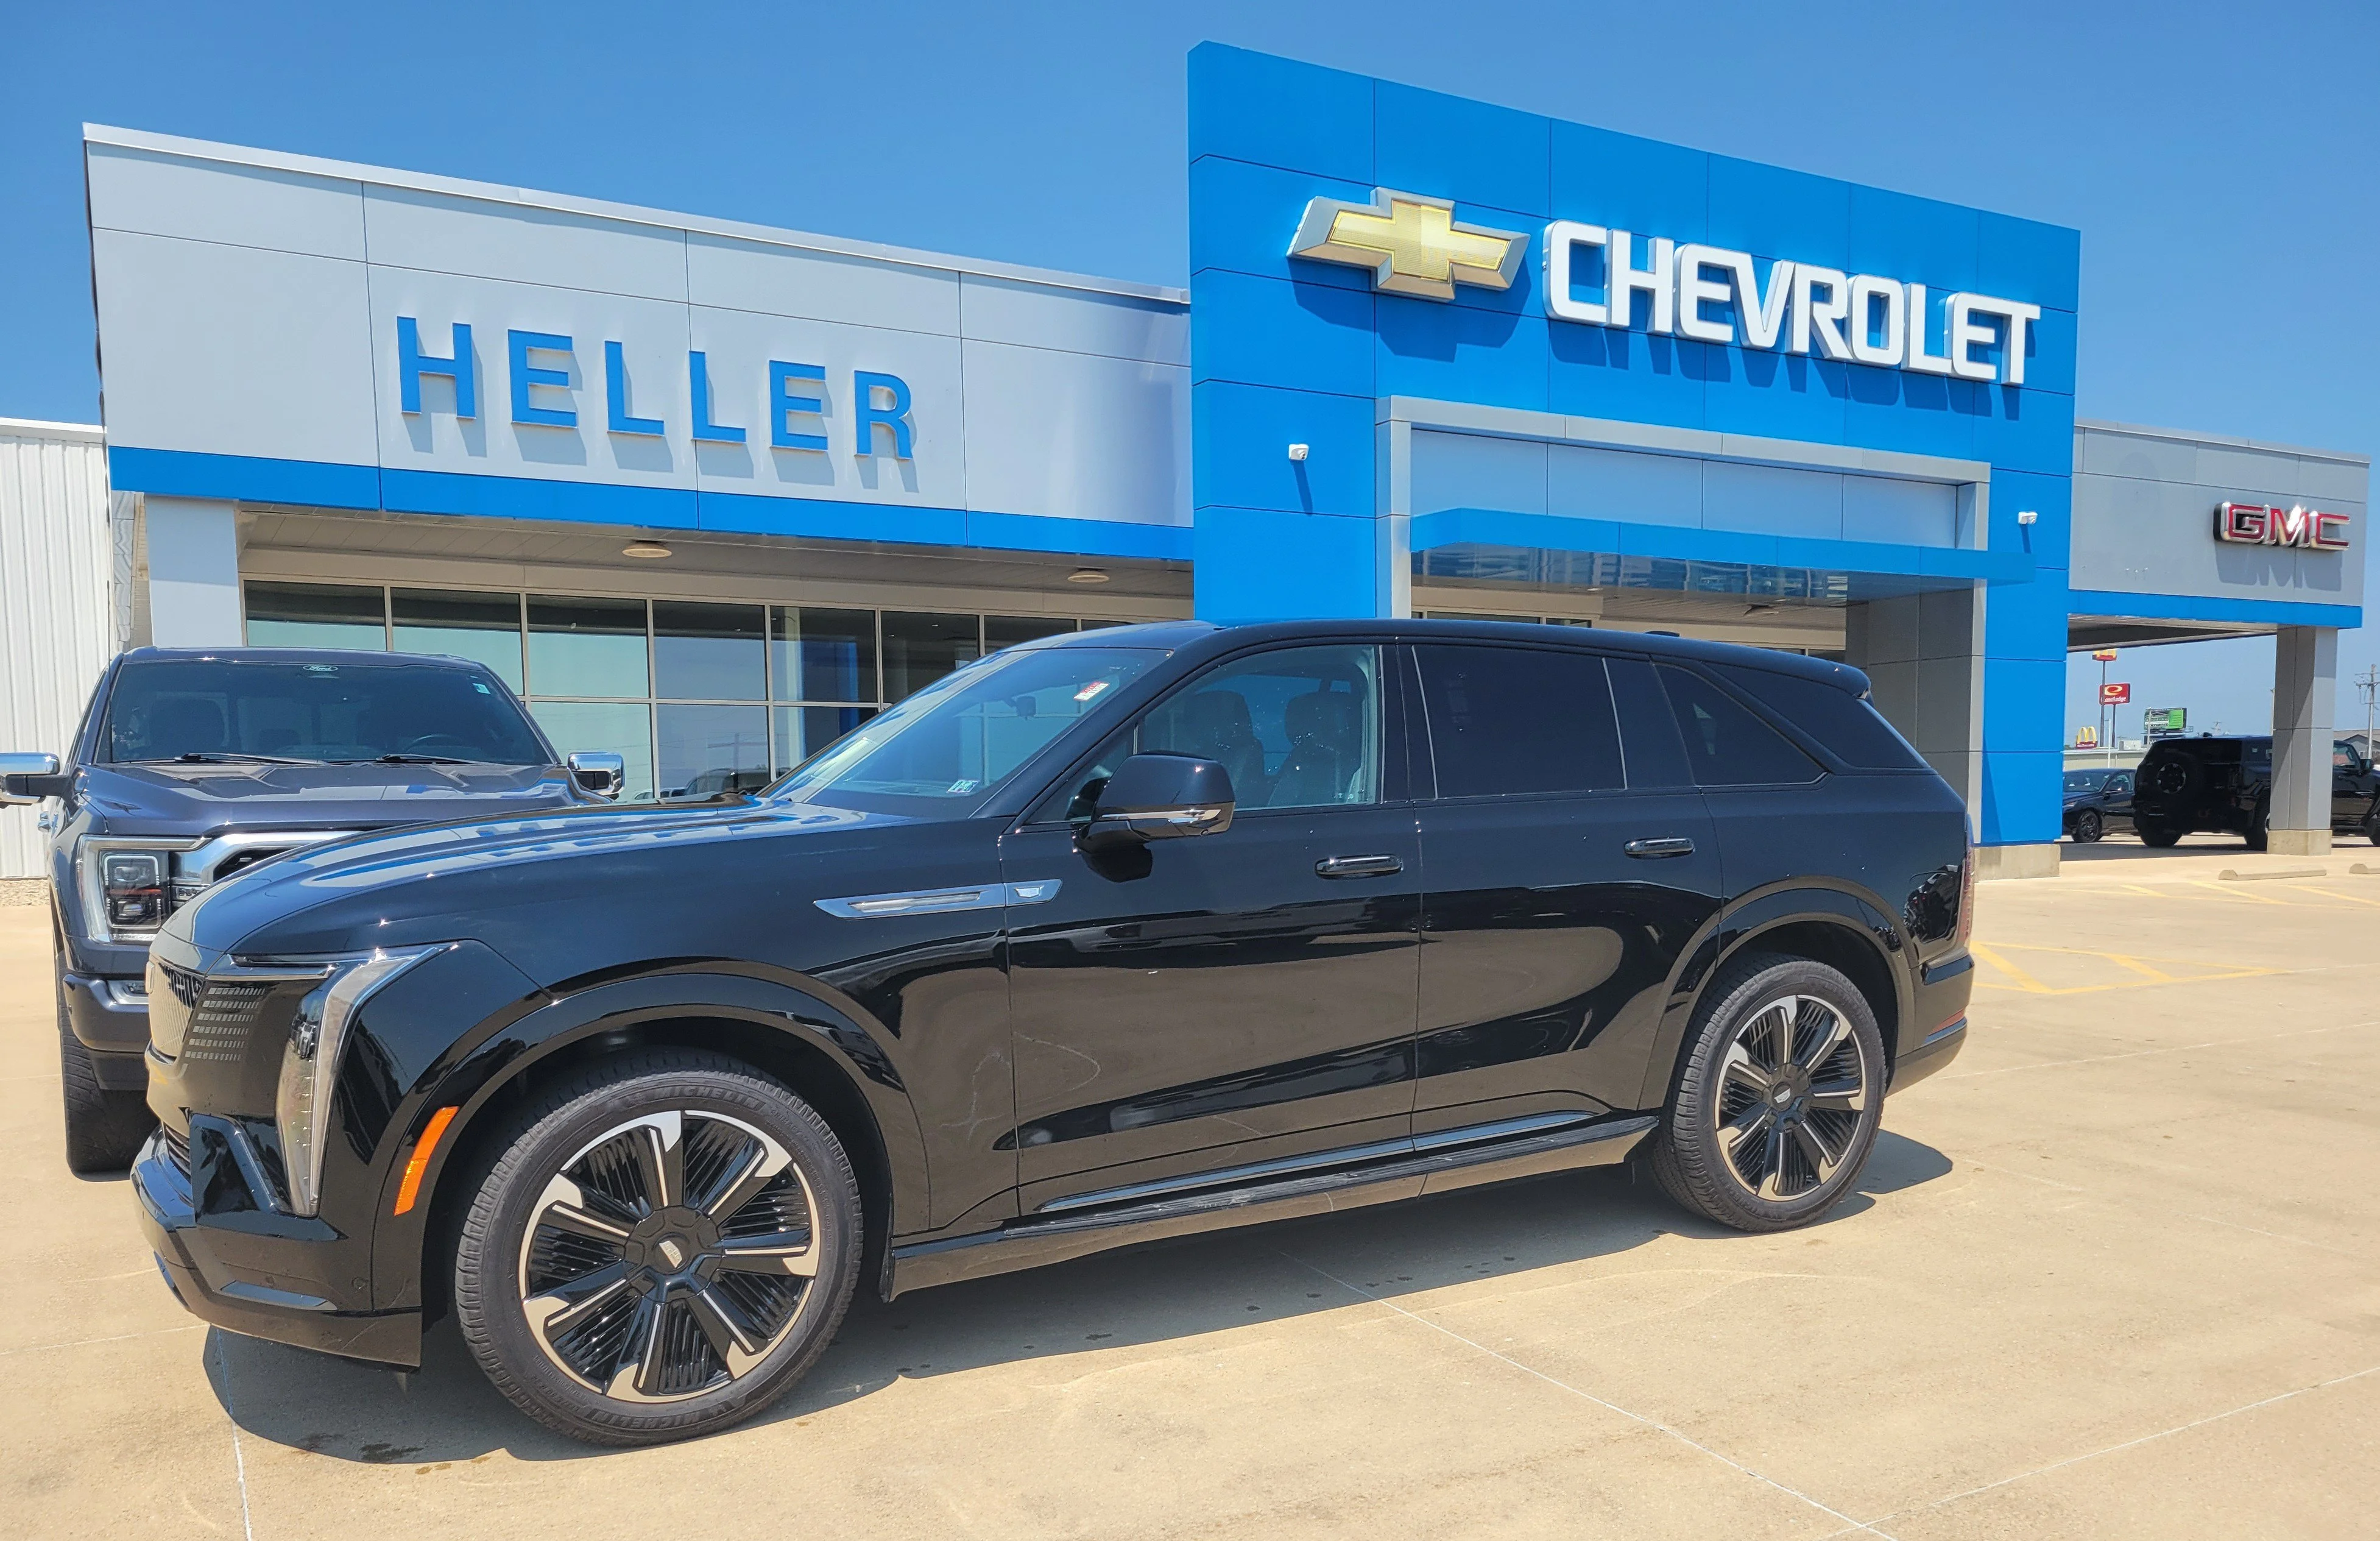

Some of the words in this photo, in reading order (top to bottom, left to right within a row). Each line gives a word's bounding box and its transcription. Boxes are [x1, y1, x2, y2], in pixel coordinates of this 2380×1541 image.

[1542, 219, 2041, 385] CHEVROLET
[397, 316, 912, 459] HELLER
[2213, 501, 2350, 551] GMC
[654, 1086, 760, 1110] MICHELIN
[593, 1409, 702, 1429] MICHELIN
